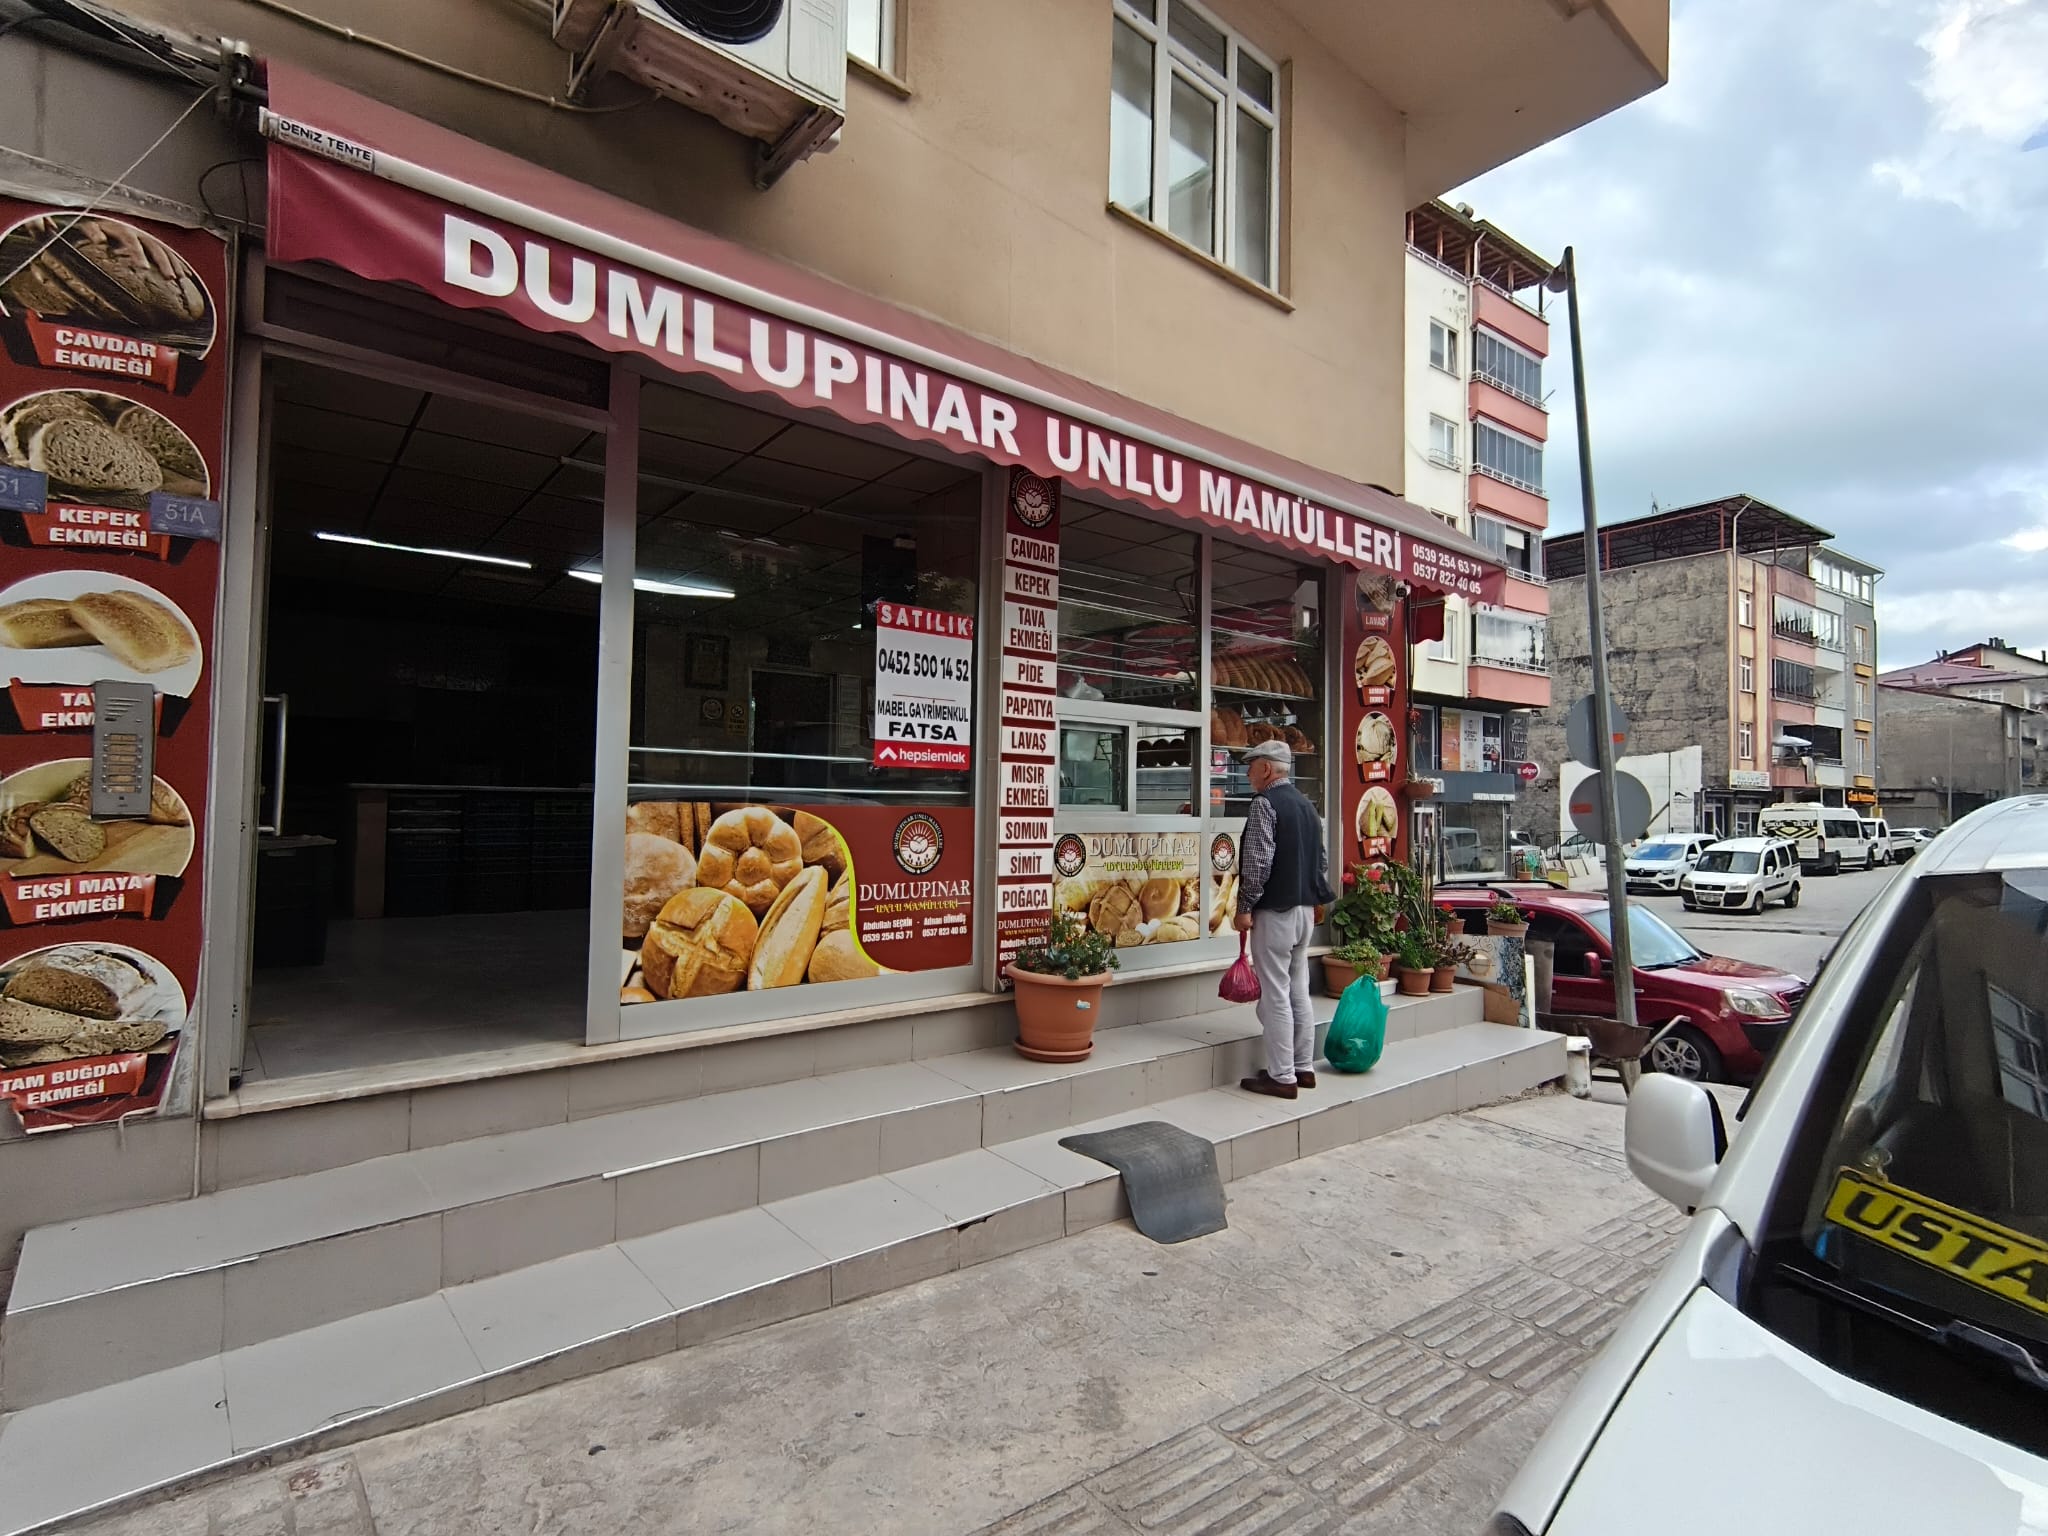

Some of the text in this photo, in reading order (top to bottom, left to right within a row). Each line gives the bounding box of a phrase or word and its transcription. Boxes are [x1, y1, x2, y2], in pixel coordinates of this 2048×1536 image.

[327, 136, 372, 161] TENTE
[55, 329, 158, 358] ÇAVDAR
[54, 348, 153, 377] EKMEĞİ
[443, 212, 1402, 573] DUMLUPINAR UNLU MAMÜLLERİ
[59, 507, 142, 529] KEPEK
[163, 502, 205, 526] 51A
[49, 525, 148, 549] EKMEĞİ
[1010, 536, 1056, 565] ÇAVDAR
[1412, 543, 1437, 564] 0539
[1438, 552, 1457, 570] 254
[1457, 559, 1470, 575] 63
[1014, 571, 1051, 597] KEPEK
[1413, 561, 1482, 595] 0537 823 40 05
[880, 603, 970, 636] SATILIK
[1018, 606, 1046, 629] TAVA
[1010, 628, 1053, 652] EKMEĞİ
[878, 647, 970, 682] 0452 500 14 52
[1017, 660, 1044, 684] PİDE
[877, 698, 969, 723] MABEL GAYRİMENKUL
[1005, 695, 1054, 719] PAPATYA
[888, 720, 958, 742] FATSA
[1010, 731, 1047, 753] LAVAŞ
[898, 747, 966, 765] hepsiemlak
[1011, 764, 1046, 785] MISIR
[1005, 785, 1049, 807] EKMEĞİ
[1005, 821, 1048, 841] SOMUN
[1089, 837, 1197, 857] DUMLUPINAR
[1010, 852, 1043, 875] SİMİT
[17, 875, 144, 901] EKŞİ MAYA
[859, 879, 972, 901] DUMLUPINAR
[1002, 886, 1049, 910] POĞAÇA
[35, 893, 125, 920] EKMEĞİ
[881, 930, 894, 941] 254
[905, 930, 914, 940] 71
[1, 1060, 131, 1093] TAM BUĞDAY
[27, 1080, 105, 1105] EKMEĞİ
[1843, 1190, 2048, 1303] USTA
